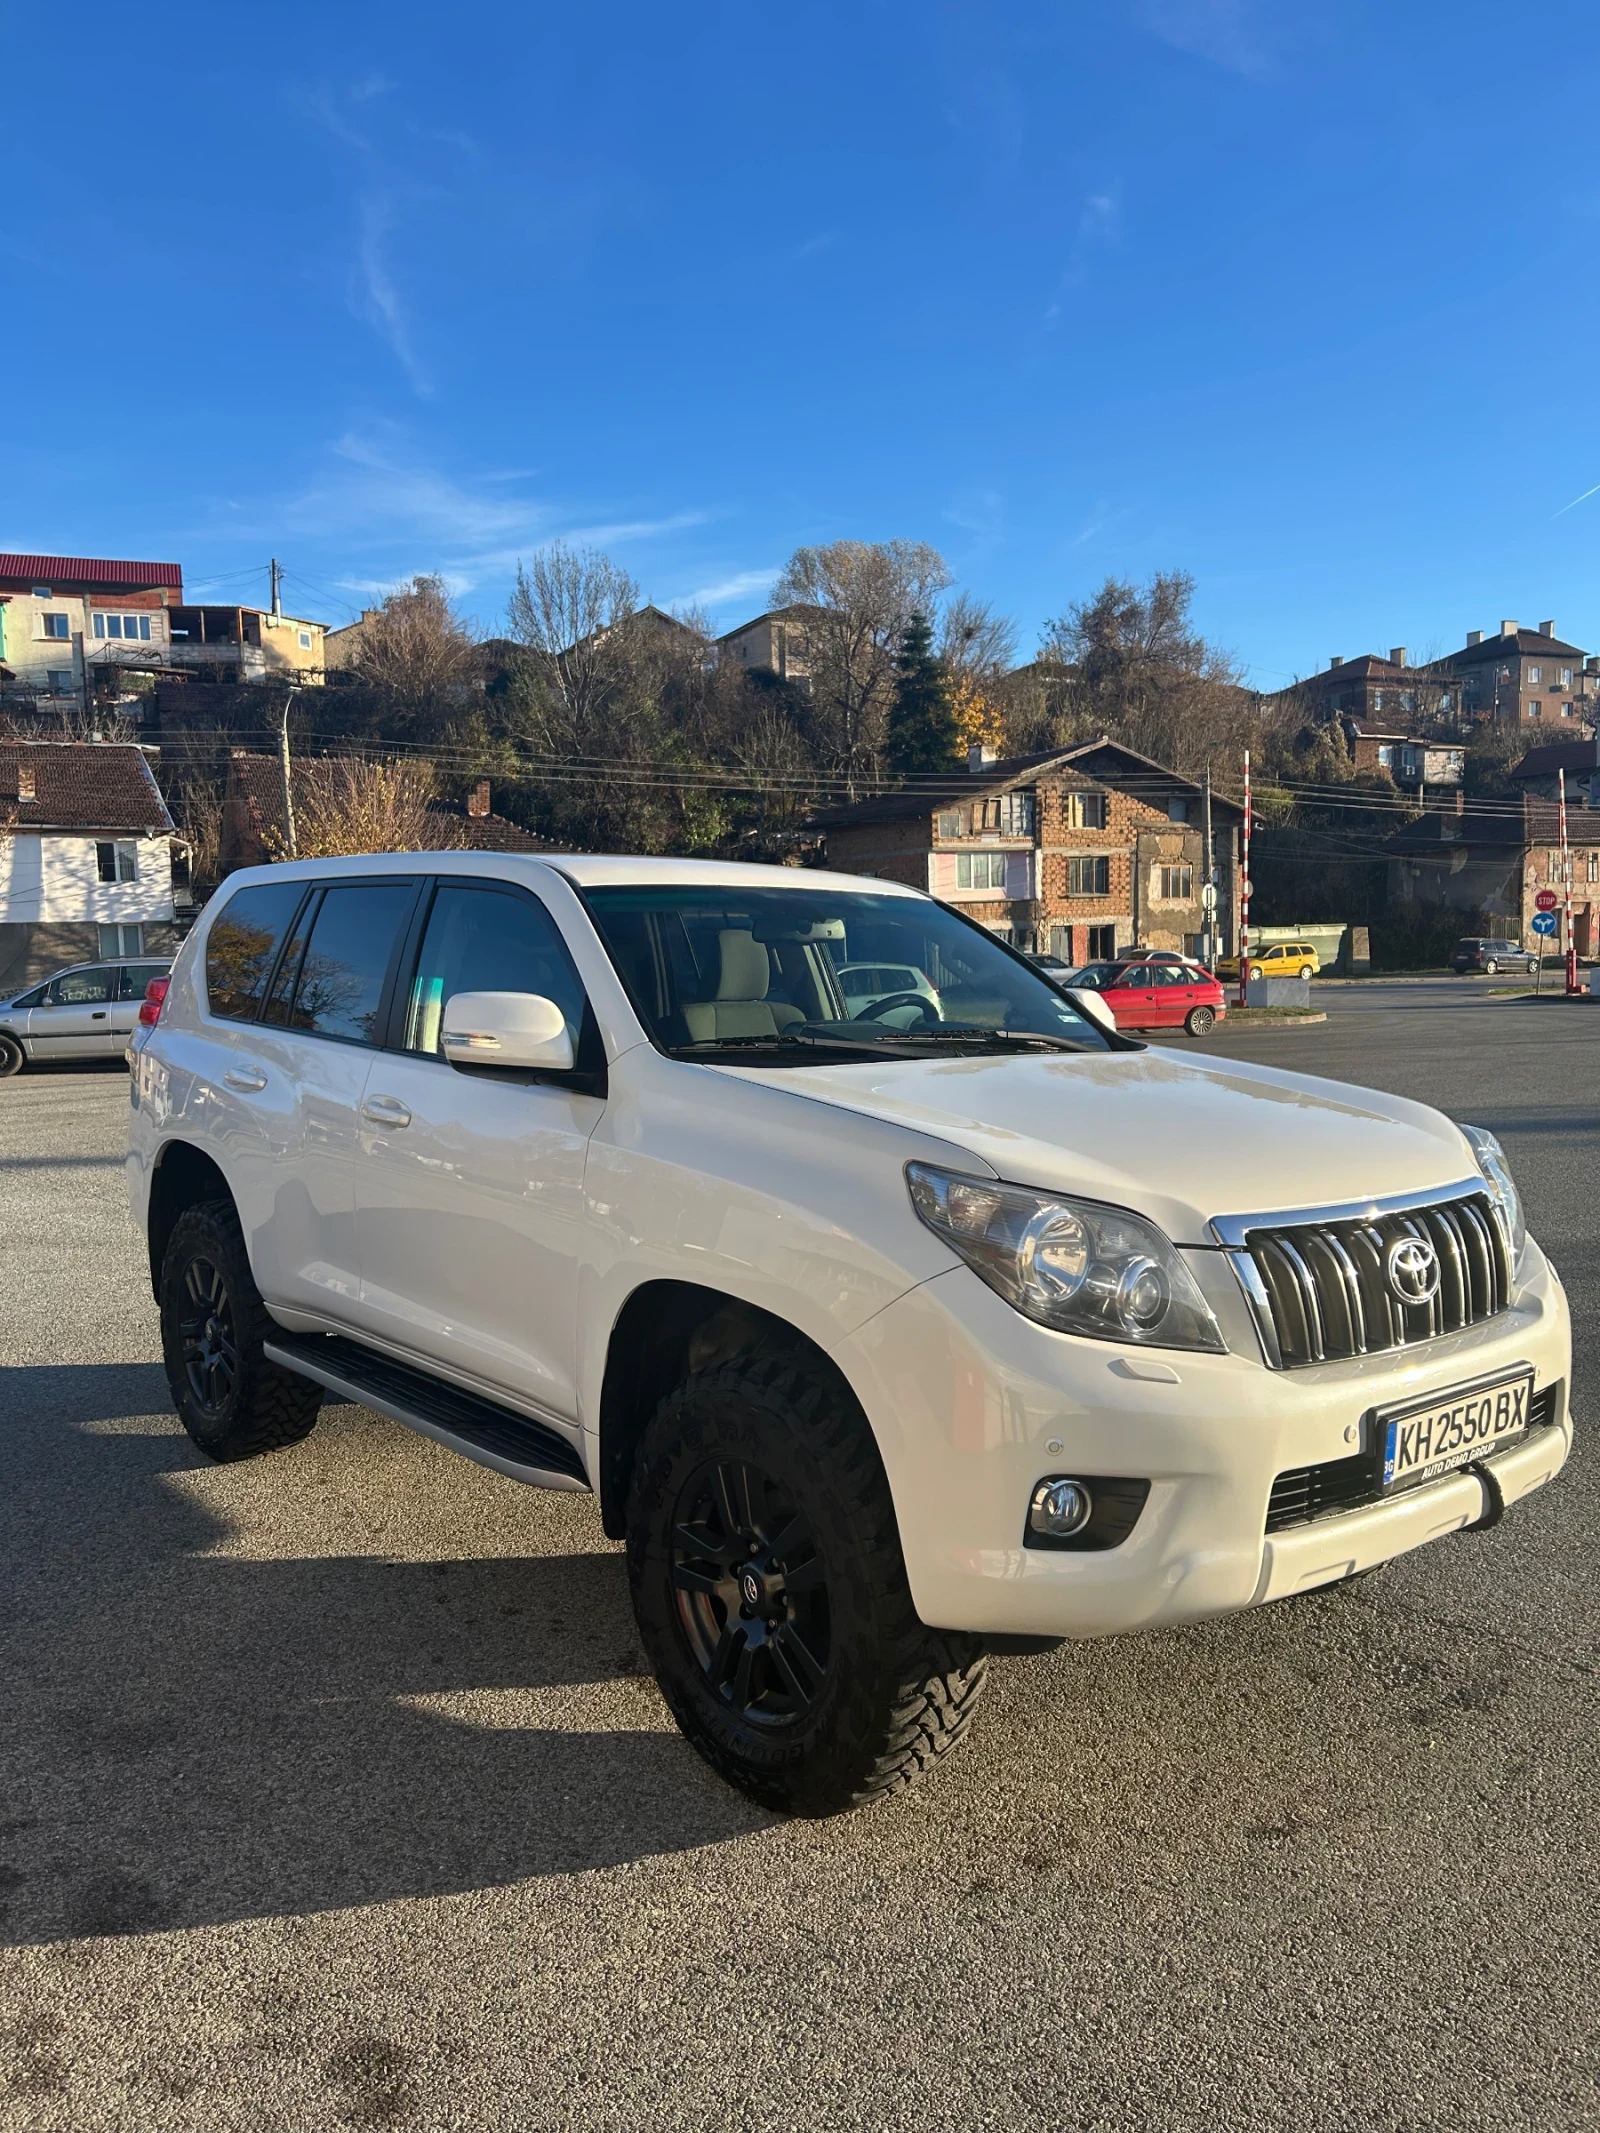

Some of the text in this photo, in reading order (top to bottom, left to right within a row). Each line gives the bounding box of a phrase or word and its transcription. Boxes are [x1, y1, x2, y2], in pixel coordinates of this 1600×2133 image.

[1538, 896, 1555, 905] STOP
[1421, 1442, 1496, 1480] AUTO DEMO GROUP
